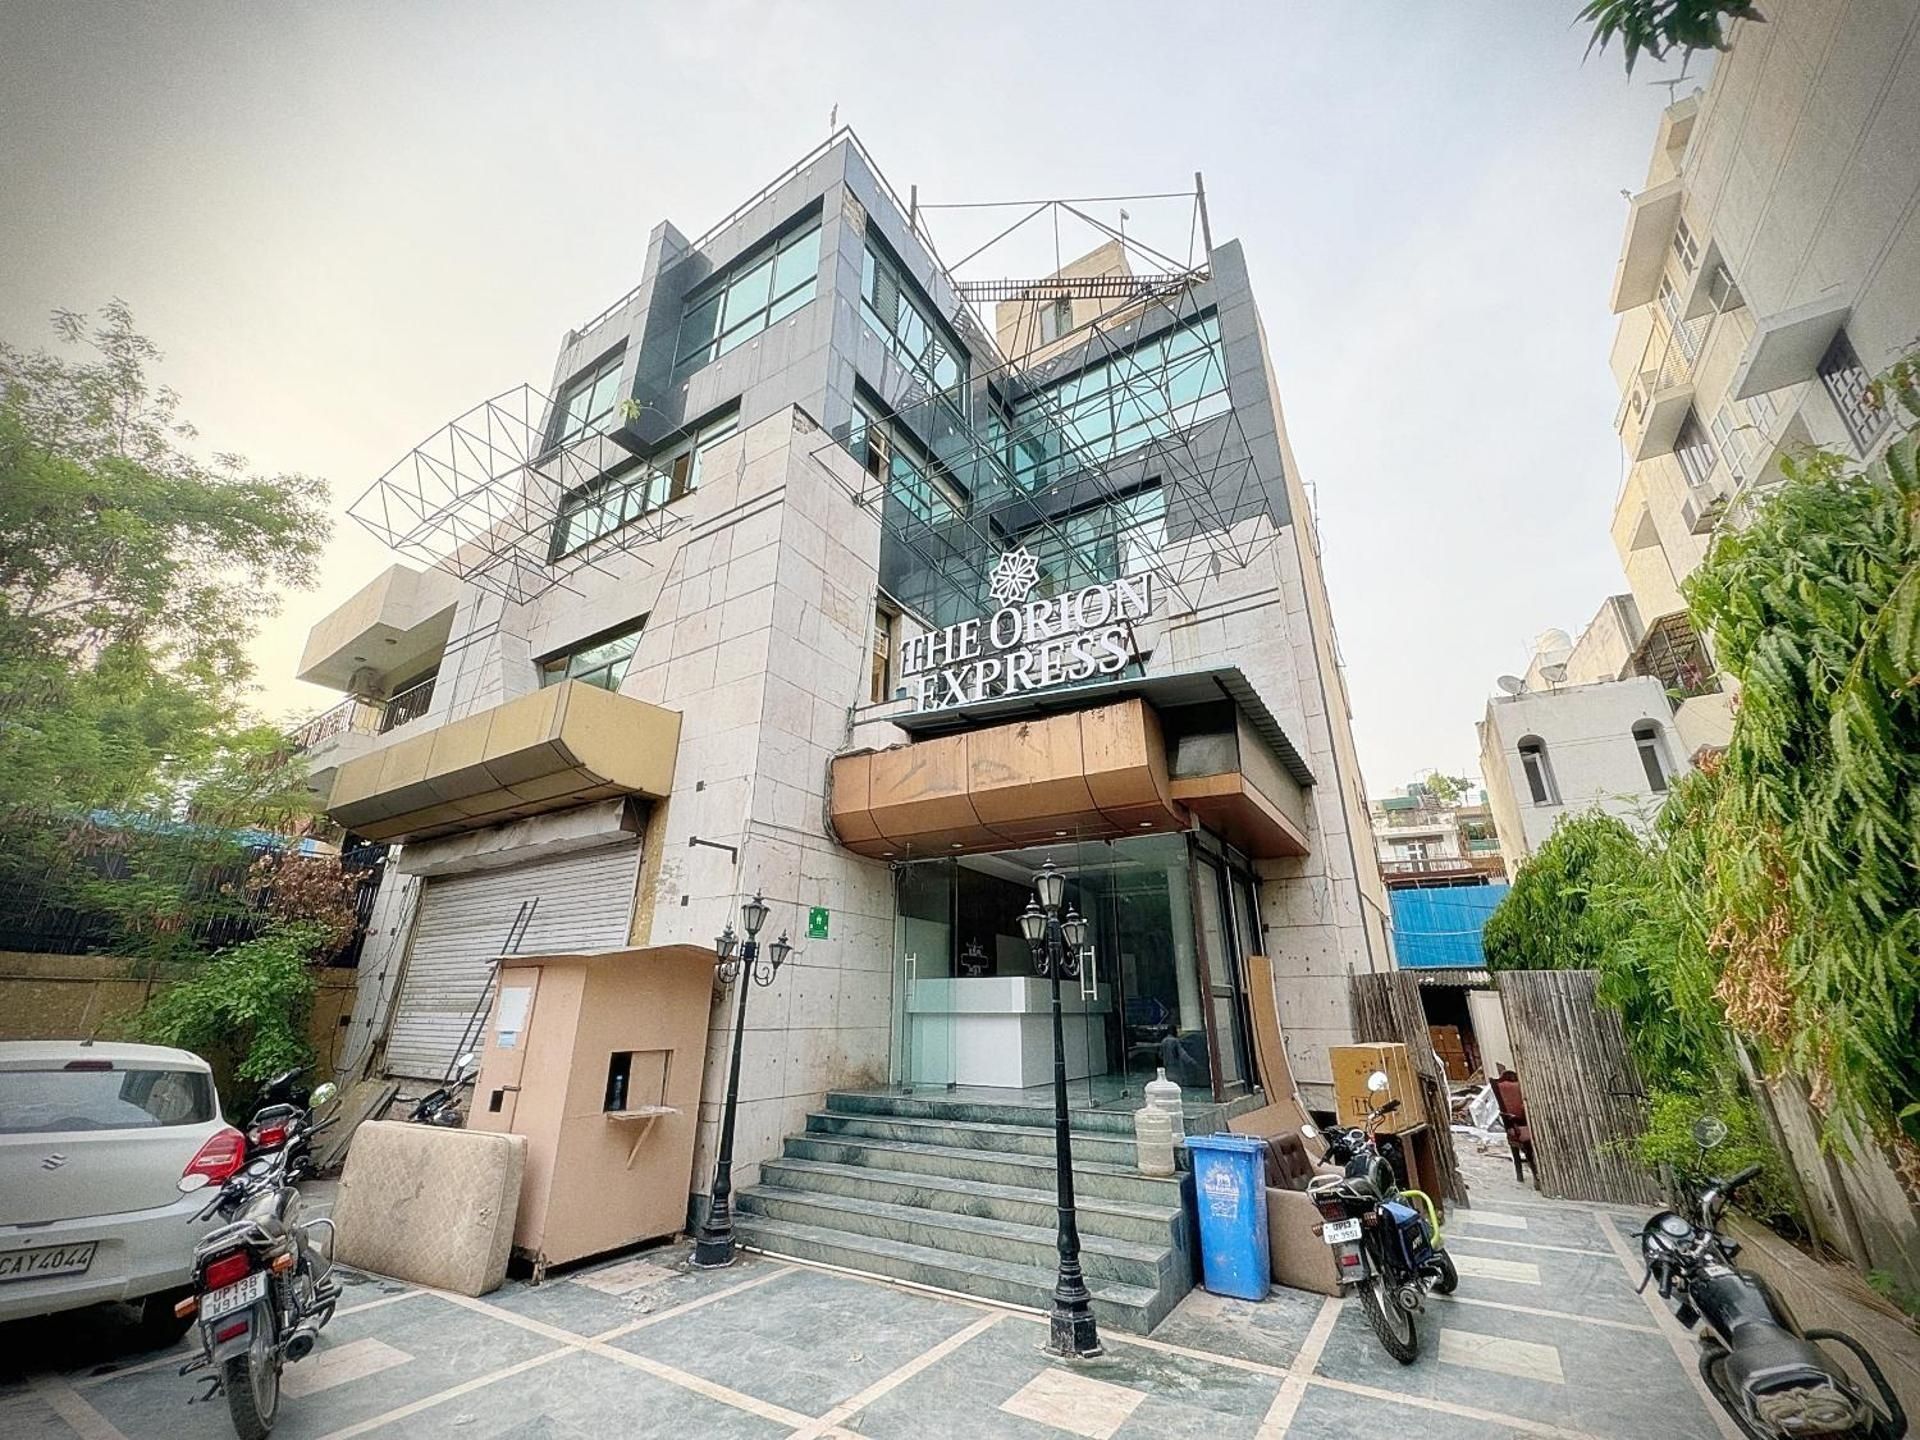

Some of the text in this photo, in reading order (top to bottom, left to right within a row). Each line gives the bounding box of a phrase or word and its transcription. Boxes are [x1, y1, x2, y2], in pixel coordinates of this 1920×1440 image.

[901, 572, 1152, 675] THE ORION
[917, 626, 1130, 713] EXPRESS
[0, 1247, 91, 1275] CAY4044
[213, 1275, 257, 1302] UP13B
